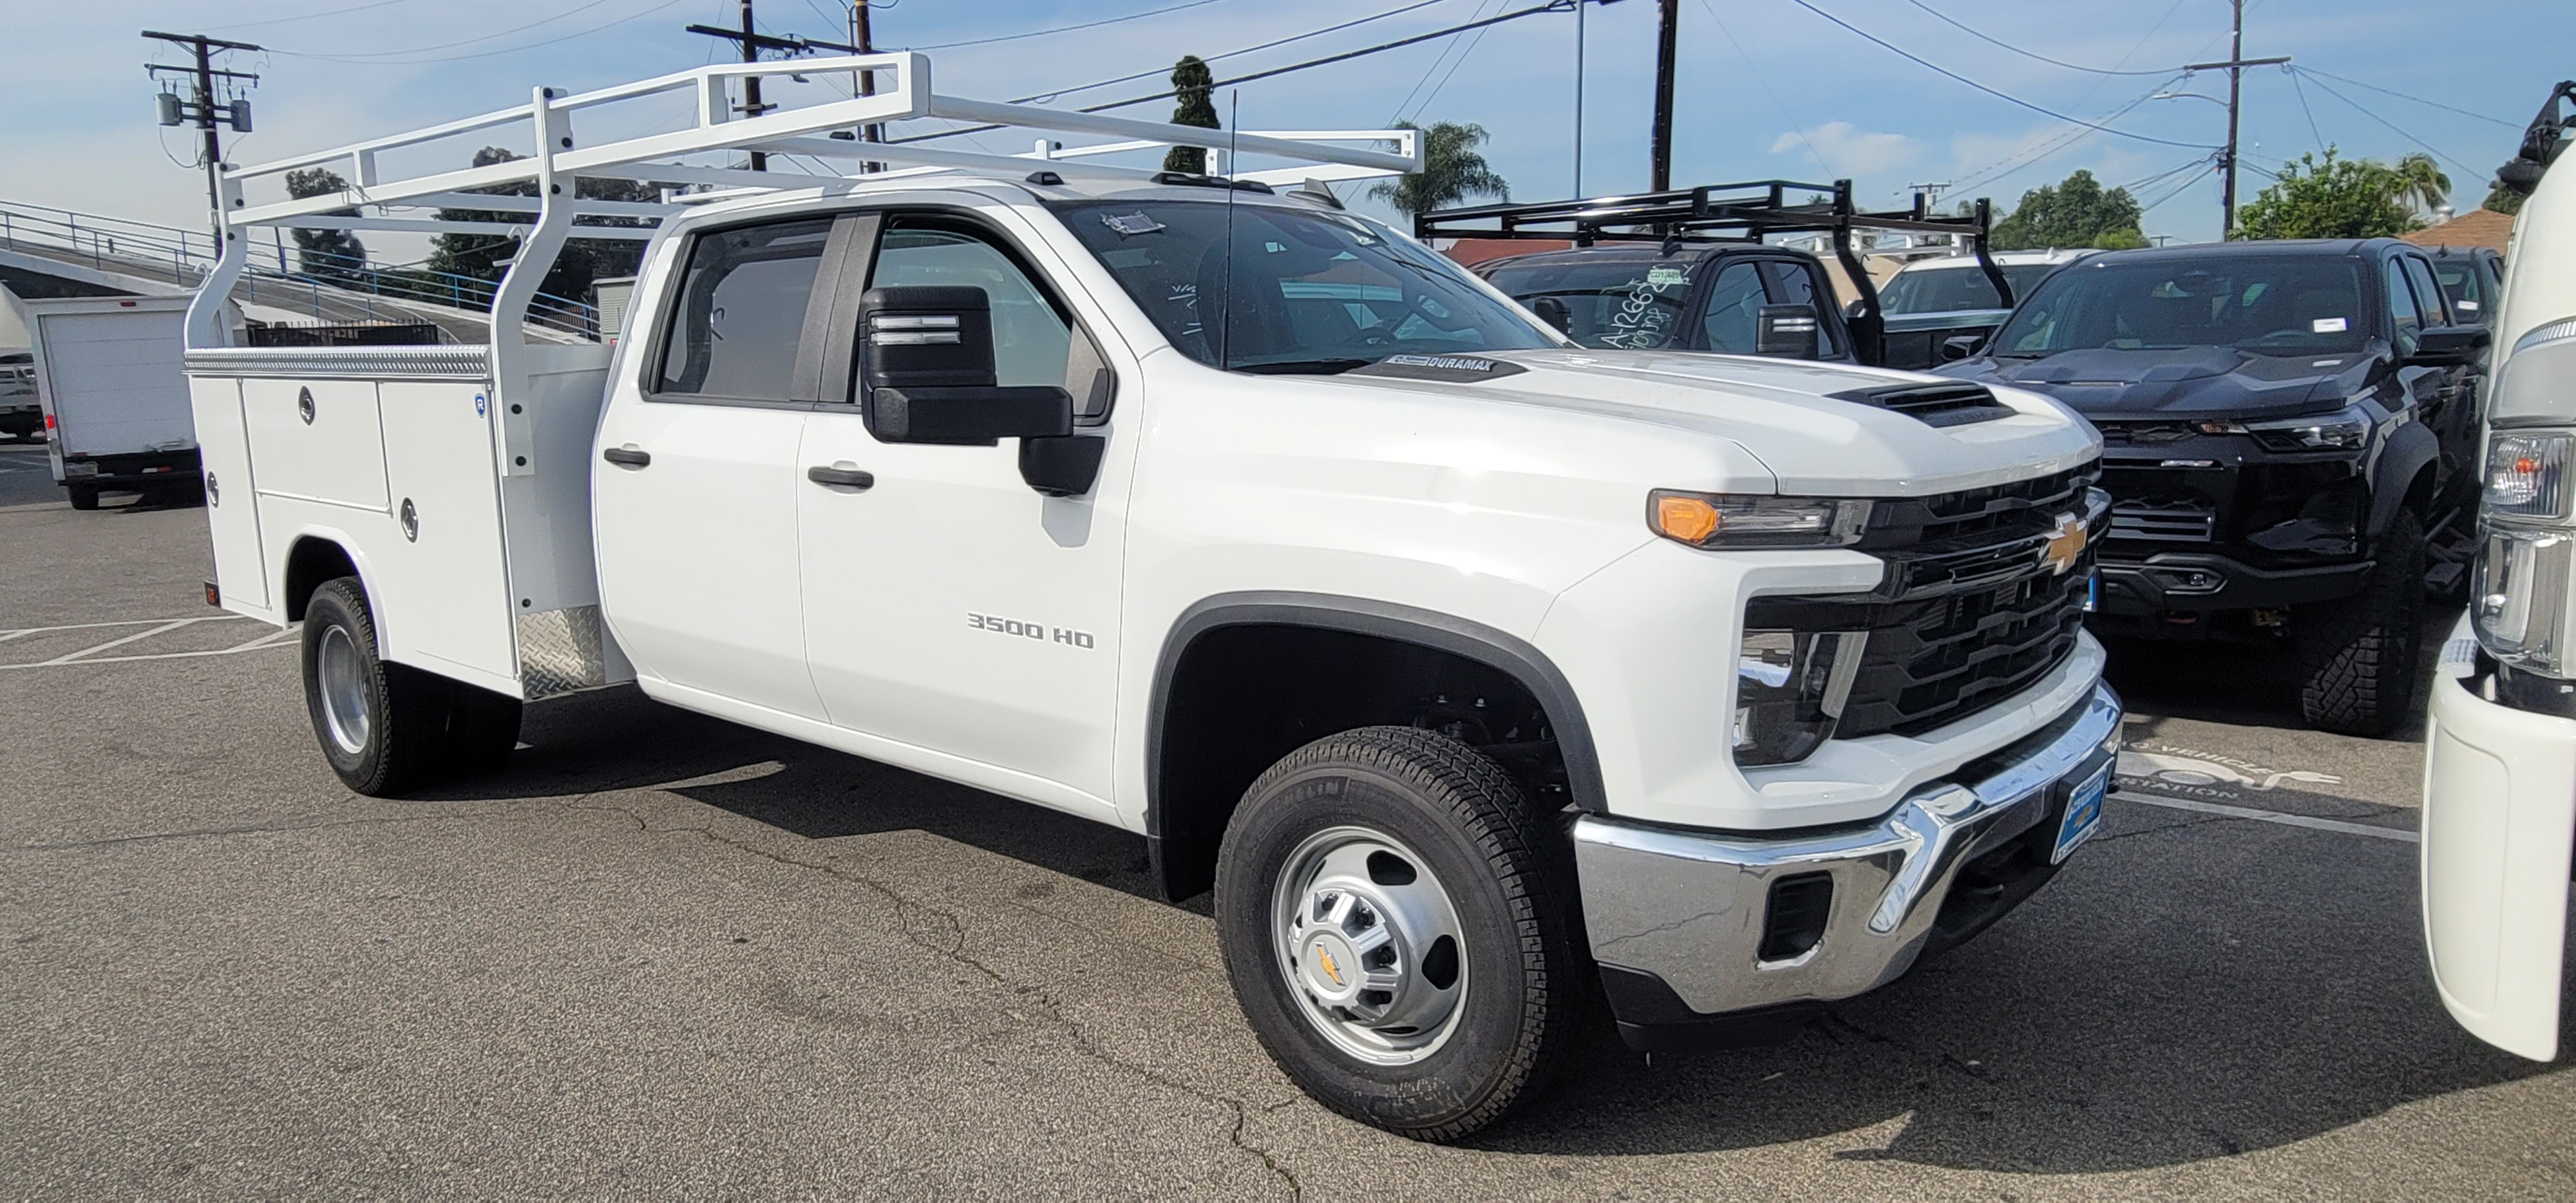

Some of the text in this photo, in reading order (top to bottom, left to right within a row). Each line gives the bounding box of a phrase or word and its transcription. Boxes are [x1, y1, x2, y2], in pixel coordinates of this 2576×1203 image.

[1427, 357, 1493, 371] DURAMAX
[477, 399, 484, 410] R
[967, 612, 1094, 649] 3500 HD
